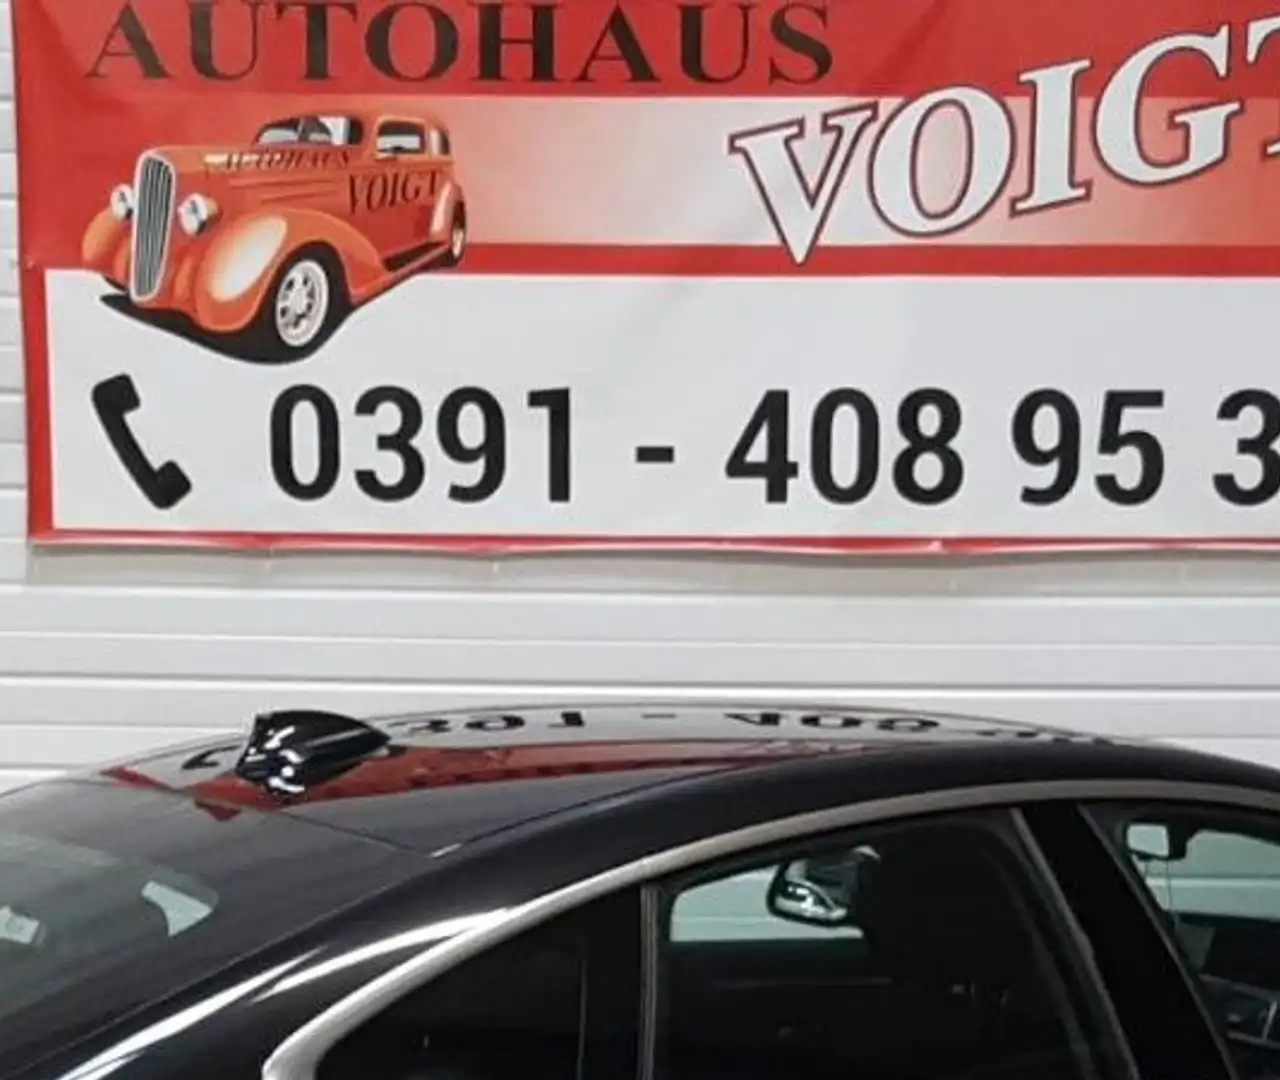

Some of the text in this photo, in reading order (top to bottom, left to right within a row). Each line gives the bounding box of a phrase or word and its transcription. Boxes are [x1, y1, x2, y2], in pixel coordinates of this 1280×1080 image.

[84, 0, 834, 84] AUTOHAUS
[348, 169, 440, 214] VOIGT
[270, 384, 571, 502] 0391
[724, 387, 963, 505] 408
[1011, 388, 1164, 506] 95
